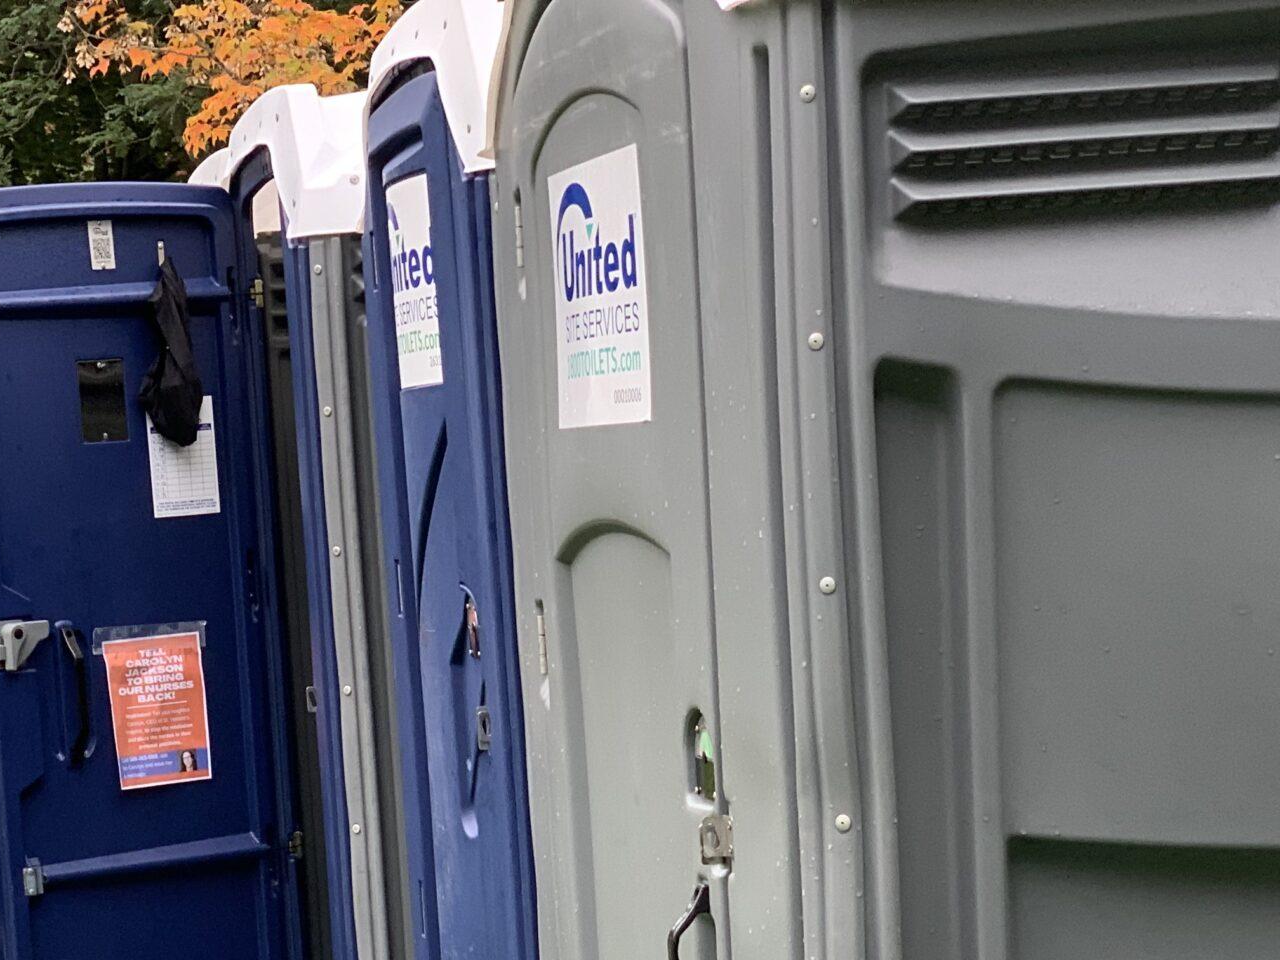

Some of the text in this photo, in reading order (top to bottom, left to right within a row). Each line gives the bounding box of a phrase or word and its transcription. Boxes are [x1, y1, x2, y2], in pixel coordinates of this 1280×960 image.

[392, 233, 435, 294] nited
[562, 214, 637, 302] United
[566, 302, 640, 343] SITE SERVICES
[567, 346, 642, 380] 1800TOILETS.com
[139, 648, 166, 658] TELL
[125, 656, 183, 668] CAROLYN
[125, 665, 184, 678] JACKSON
[127, 674, 184, 686] TO BRING
[119, 681, 194, 696] OUR NURSES
[137, 692, 176, 703] BACK!
